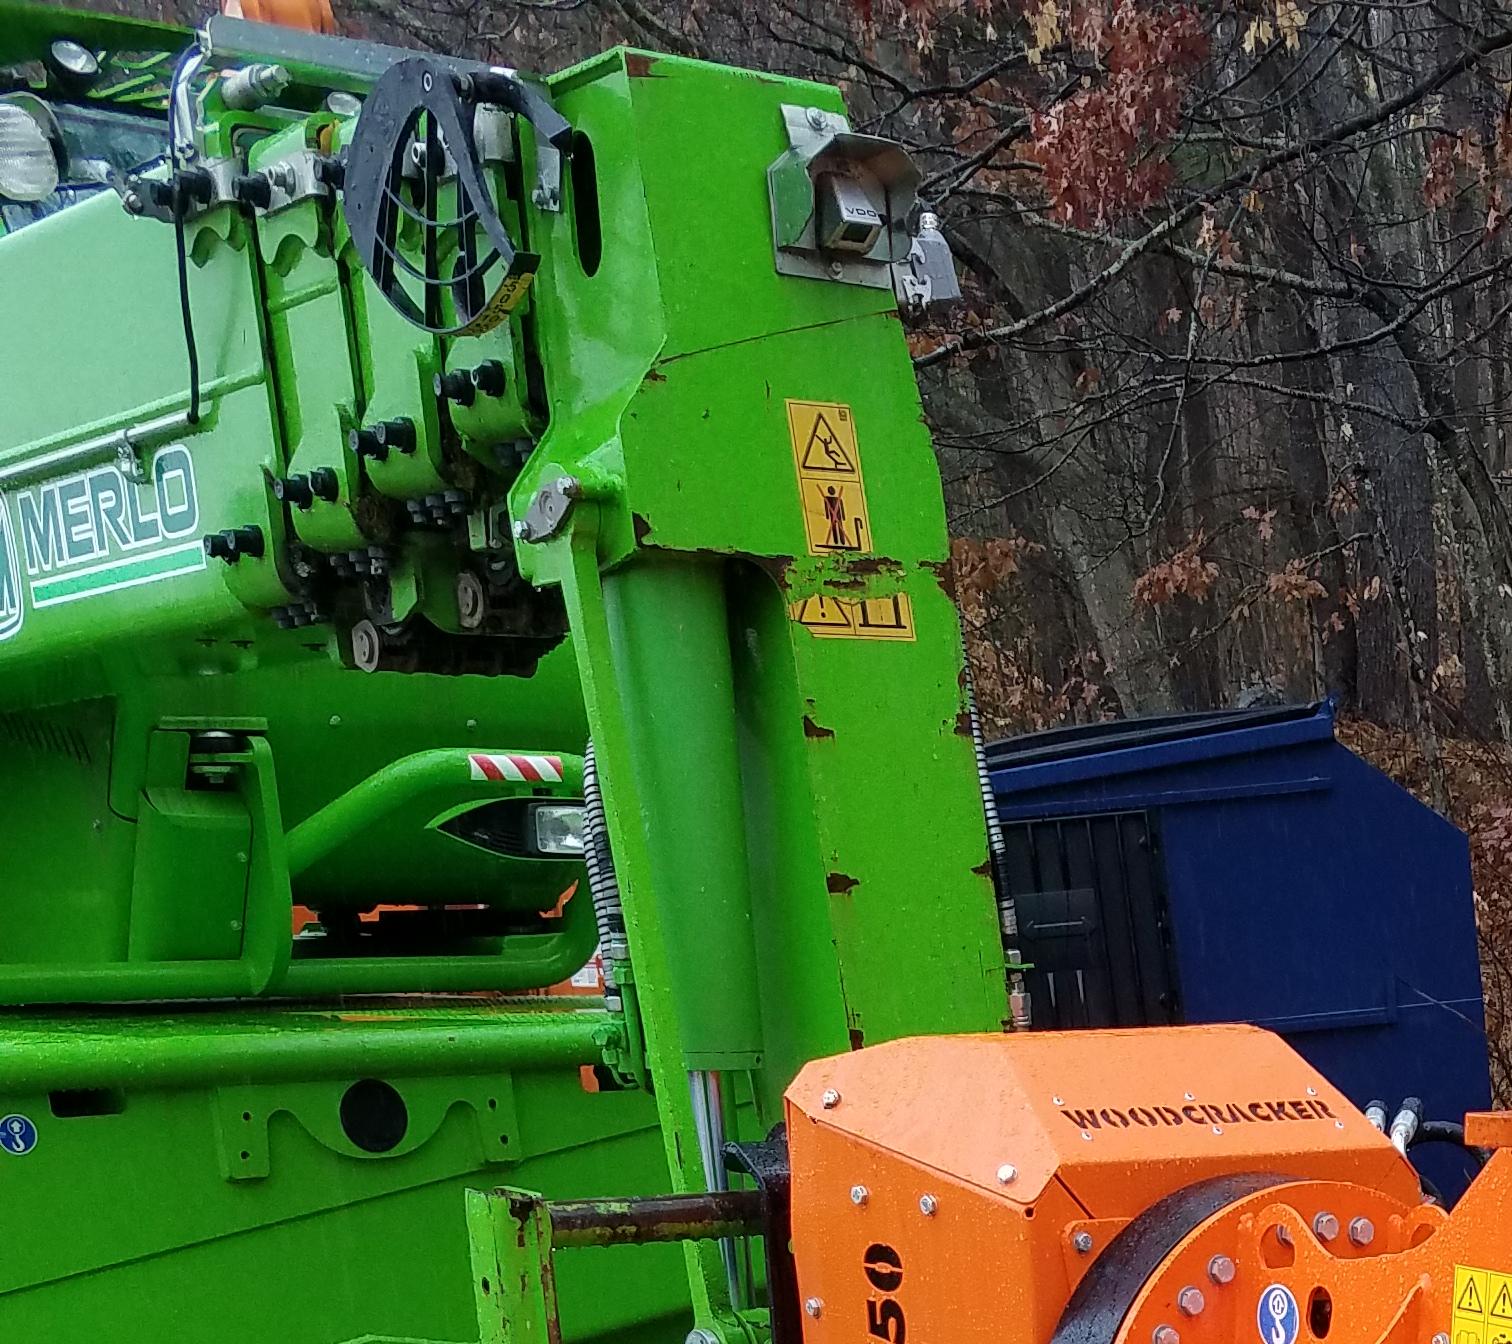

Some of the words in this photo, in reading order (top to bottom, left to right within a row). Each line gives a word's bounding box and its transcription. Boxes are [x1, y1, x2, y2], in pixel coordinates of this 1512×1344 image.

[845, 206, 878, 218] VDO
[17, 445, 199, 574] MERLO
[1060, 1099, 1338, 1130] WOODCRACKER
